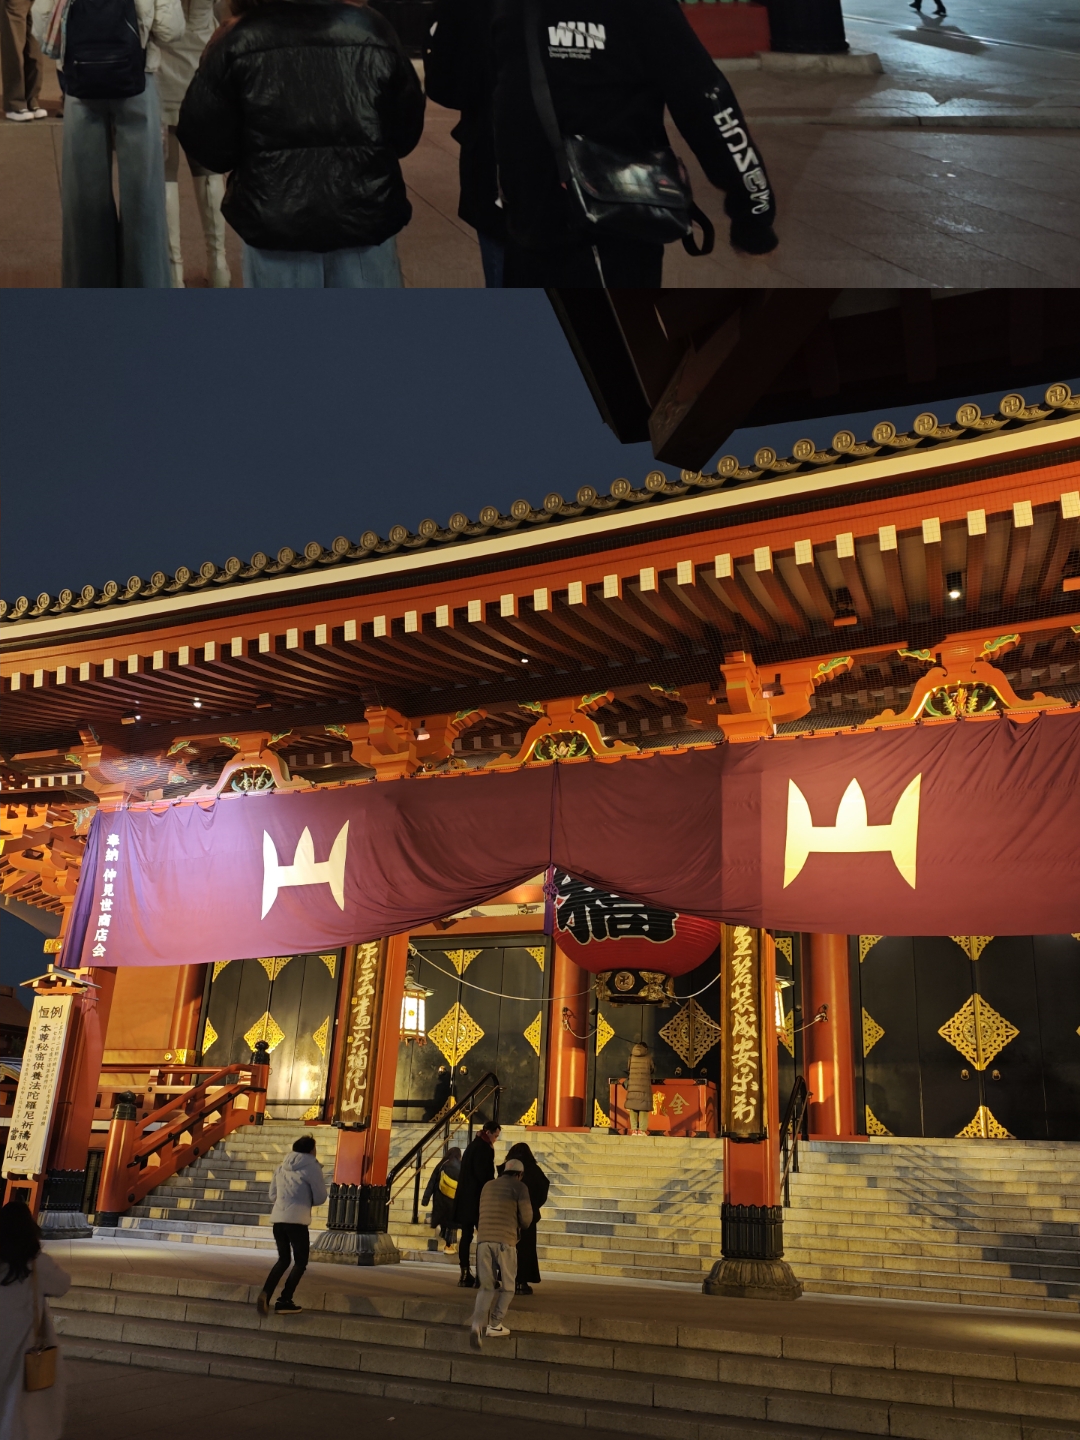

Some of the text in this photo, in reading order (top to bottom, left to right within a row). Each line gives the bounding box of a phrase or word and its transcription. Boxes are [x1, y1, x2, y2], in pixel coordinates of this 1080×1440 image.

[548, 21, 606, 50] WIN
[92, 868, 117, 957] 仲見世商店会
